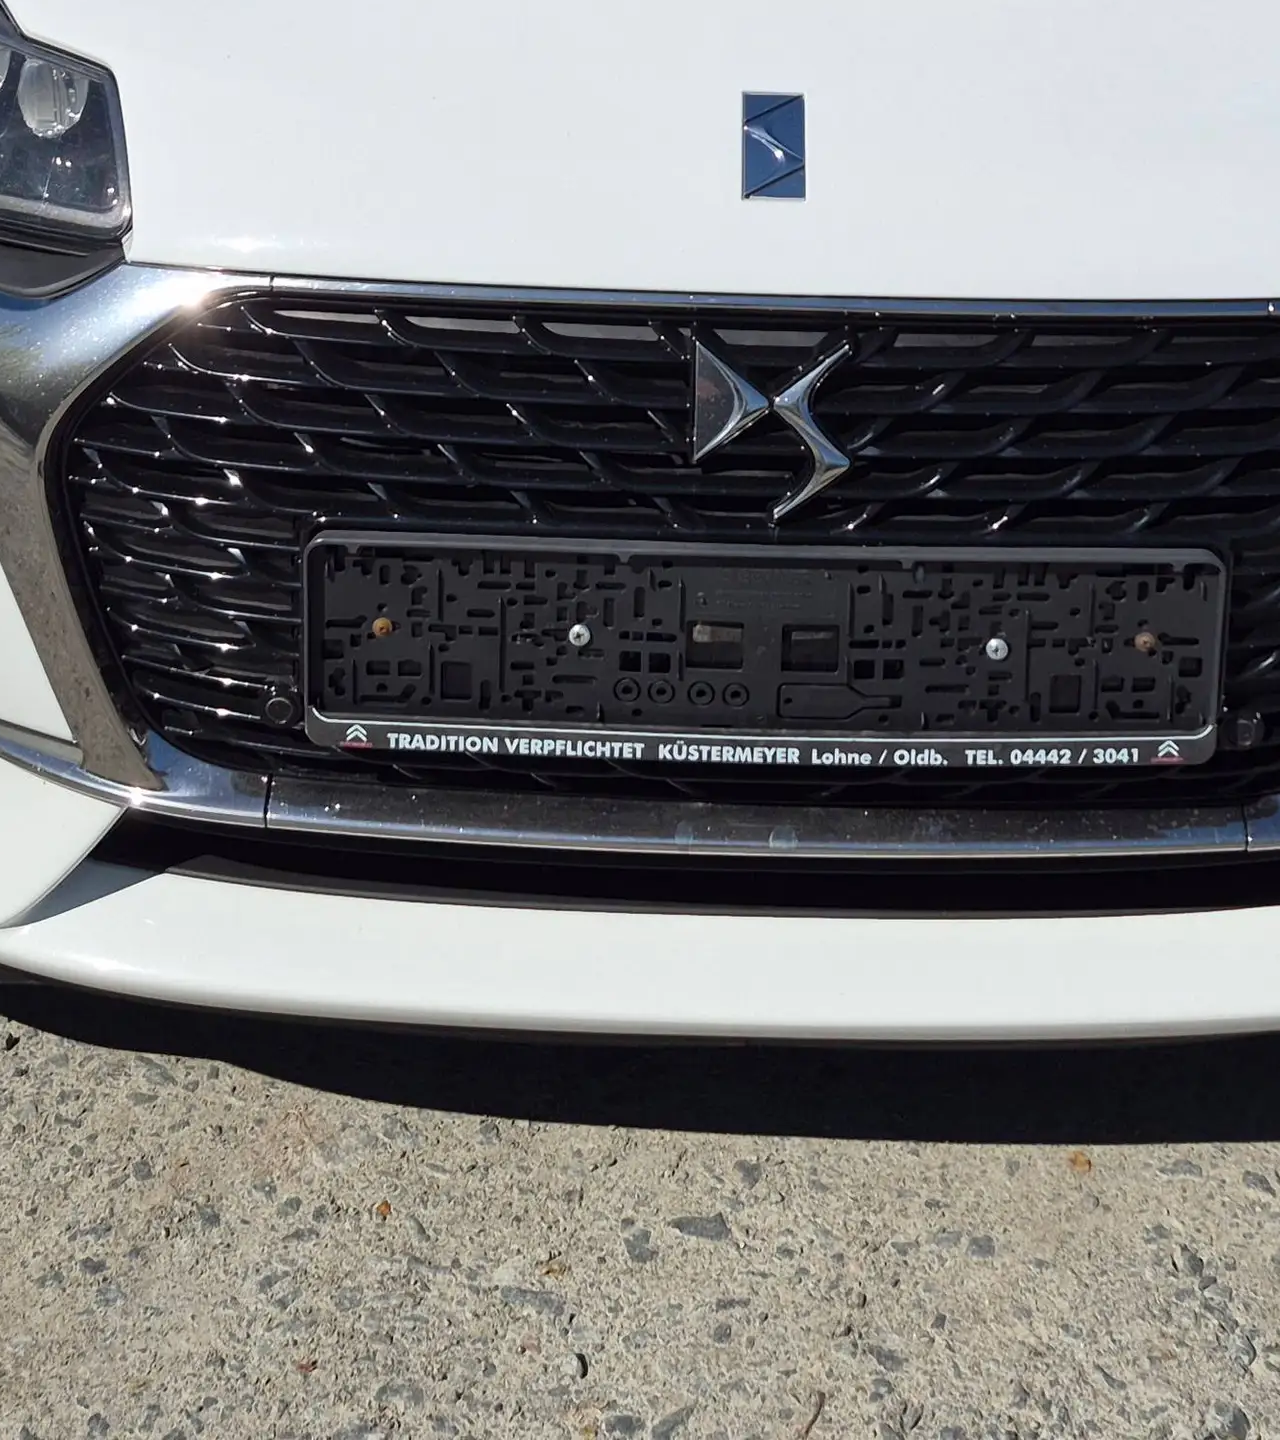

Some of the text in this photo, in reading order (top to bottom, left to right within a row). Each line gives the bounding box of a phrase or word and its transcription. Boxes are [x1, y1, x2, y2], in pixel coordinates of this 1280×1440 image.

[387, 732, 499, 754] TRADITION
[504, 737, 645, 760] VERPFLICHTET
[658, 740, 800, 765] KÜSTERMEYER
[811, 748, 872, 766] Lohne
[878, 748, 888, 765] /
[893, 748, 949, 767] Oldb.
[964, 749, 1004, 766] TEL.
[1010, 748, 1072, 765] 04442
[1078, 748, 1087, 765] /
[1092, 747, 1139, 764] 3041
